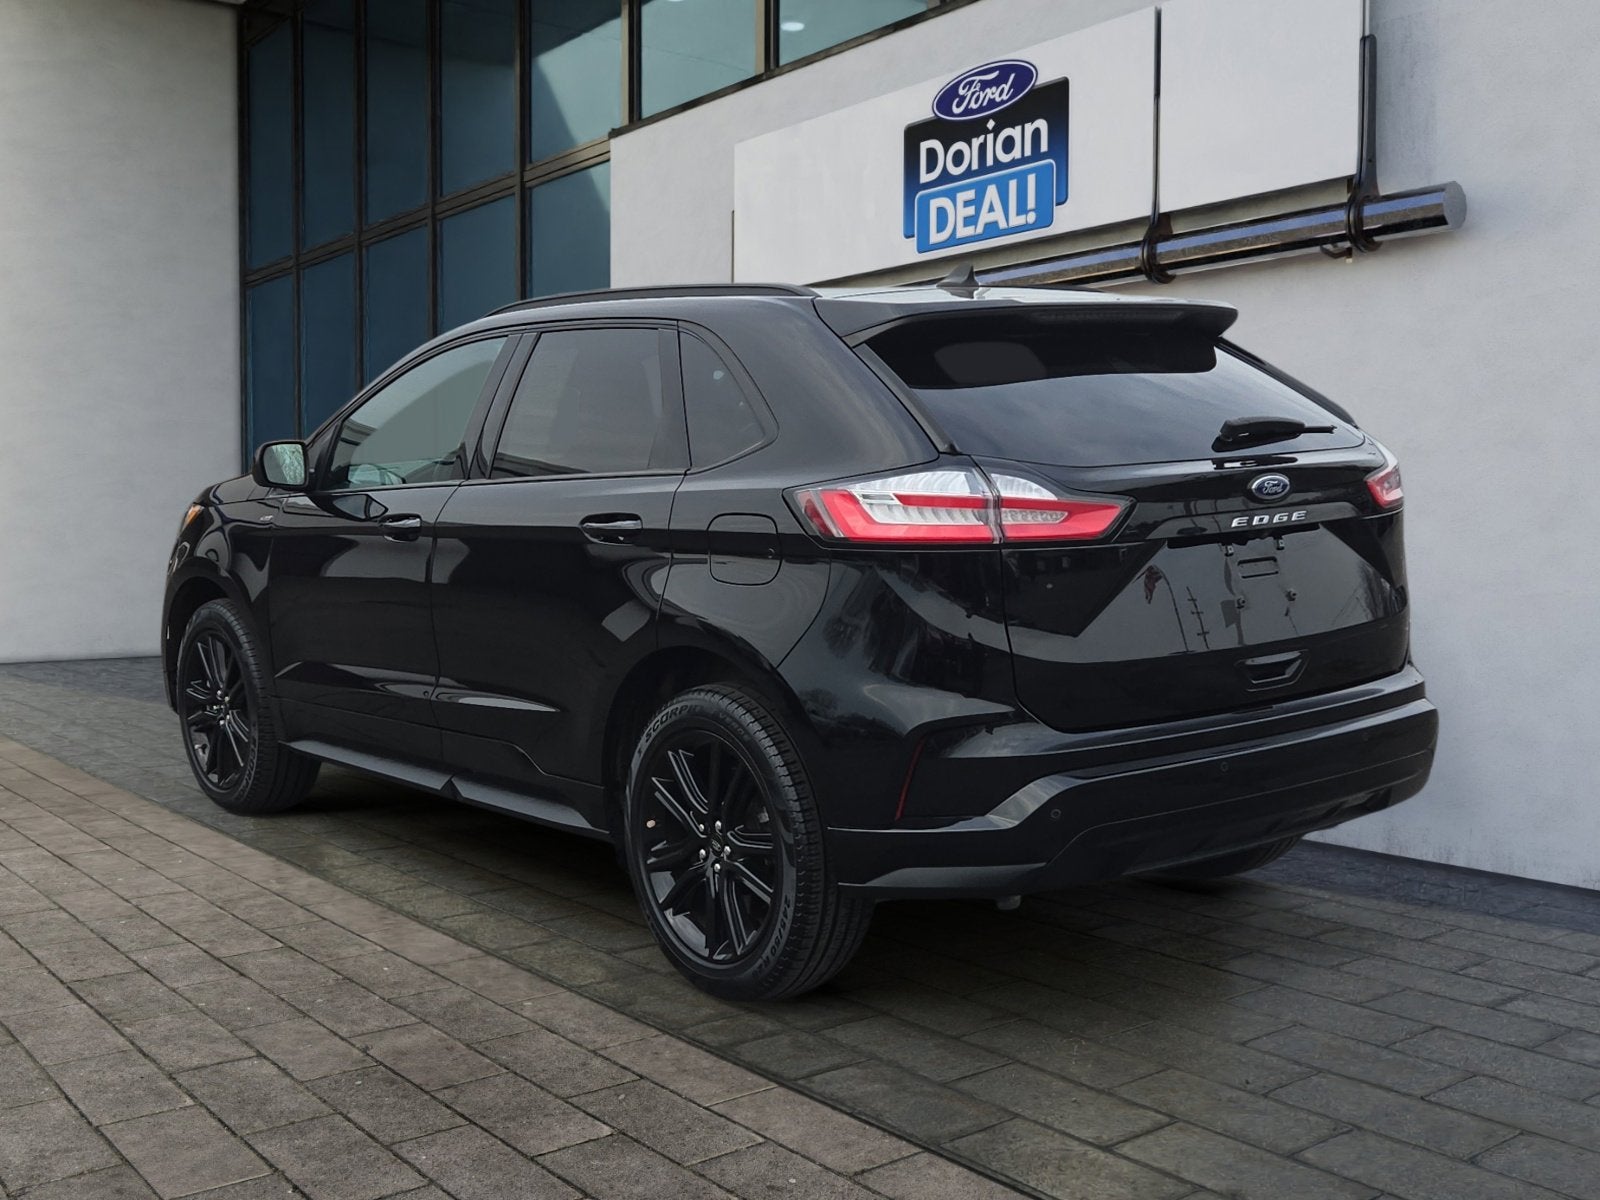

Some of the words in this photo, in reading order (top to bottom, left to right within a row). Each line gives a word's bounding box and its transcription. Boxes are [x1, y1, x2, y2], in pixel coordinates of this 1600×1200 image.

[951, 70, 1016, 115] Ford
[919, 118, 1048, 184] Dorian
[929, 173, 1036, 245] DEAL!
[1231, 510, 1307, 528] EDGE
[645, 703, 707, 743] SCORPIO
